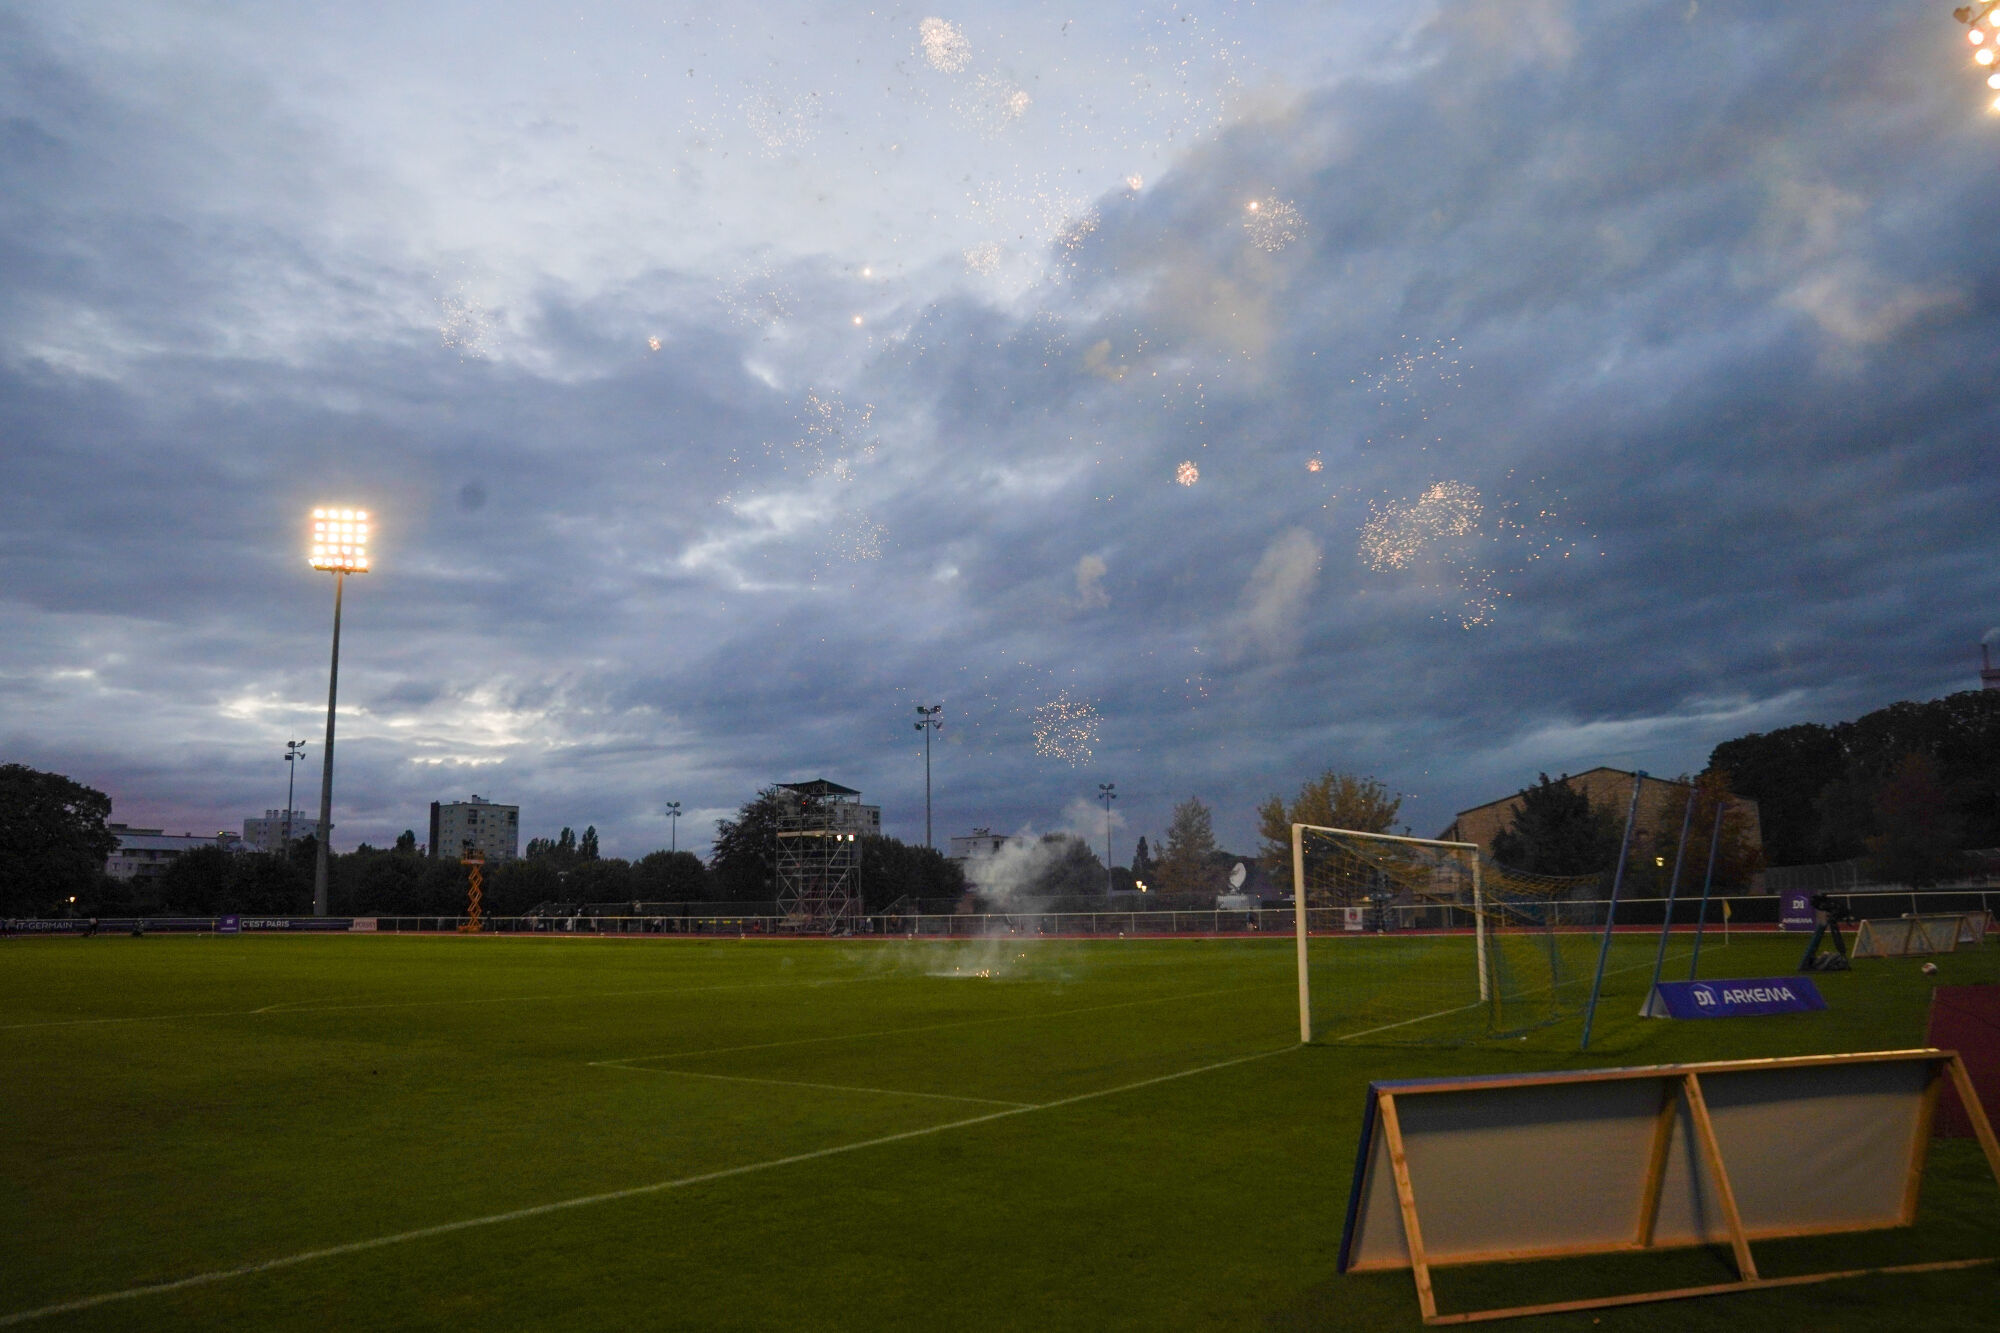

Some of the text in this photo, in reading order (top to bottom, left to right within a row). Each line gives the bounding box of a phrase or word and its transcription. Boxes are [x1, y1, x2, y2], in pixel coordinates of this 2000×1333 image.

[1792, 899, 1805, 909] D1
[242, 919, 265, 928] C'EST
[266, 919, 290, 928] PARIS
[1693, 987, 1796, 1006] D1 ARKEMA
